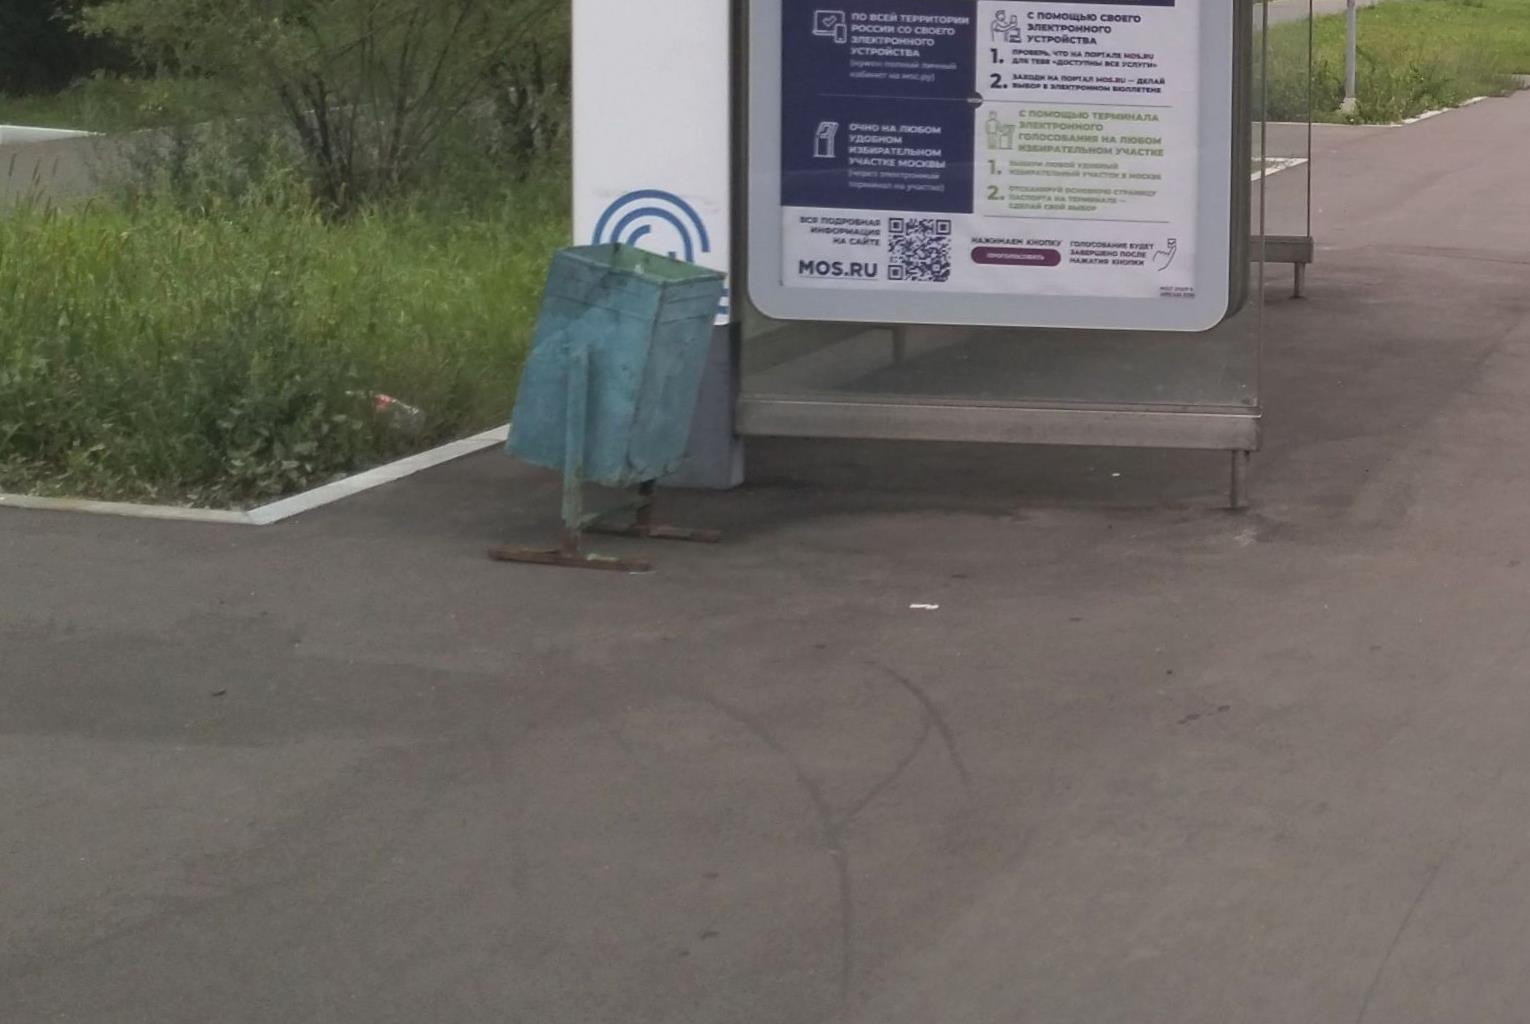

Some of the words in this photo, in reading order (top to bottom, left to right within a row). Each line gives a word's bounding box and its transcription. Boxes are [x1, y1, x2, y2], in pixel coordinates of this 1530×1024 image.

[851, 13, 867, 21] ПО
[870, 12, 897, 22] ВСЕЙ
[901, 15, 970, 24] ТЕРРИТОРИИ
[1027, 12, 1034, 20] С
[1037, 12, 1097, 22] ПОМОЩЬЮ
[1100, 14, 1141, 23] СВОЕГО
[851, 25, 895, 33] РОССИИ
[897, 26, 912, 34] СО
[914, 27, 956, 36] СВОЕГО
[1027, 24, 1111, 34] ЭЛЕКТРОННОГО
[851, 36, 935, 46] ЭЛЕКТРОННОГО
[1027, 34, 1097, 45] УСТРОЙСТВА
[850, 47, 920, 57] УСТРОЙСТВА
[990, 48, 1004, 64] 1.
[990, 74, 1007, 89] 2.
[1029, 110, 1089, 120] ПОМОЩЬЮ
[1093, 112, 1159, 122] ТЕРМИНАЛА
[849, 123, 879, 132] ОЧНО
[899, 125, 941, 134] ЛЮБОМ
[1120, 137, 1162, 145] ЛЮБОМ
[1115, 148, 1164, 157] УЧАСТКЕ
[988, 159, 1002, 175] 1.
[987, 185, 1004, 200] 2.
[821, 218, 880, 226] ПОДРОБНАЯ
[833, 237, 846, 245] НА
[850, 236, 880, 246] САЙТЕ
[799, 260, 878, 277] MOS.RU
